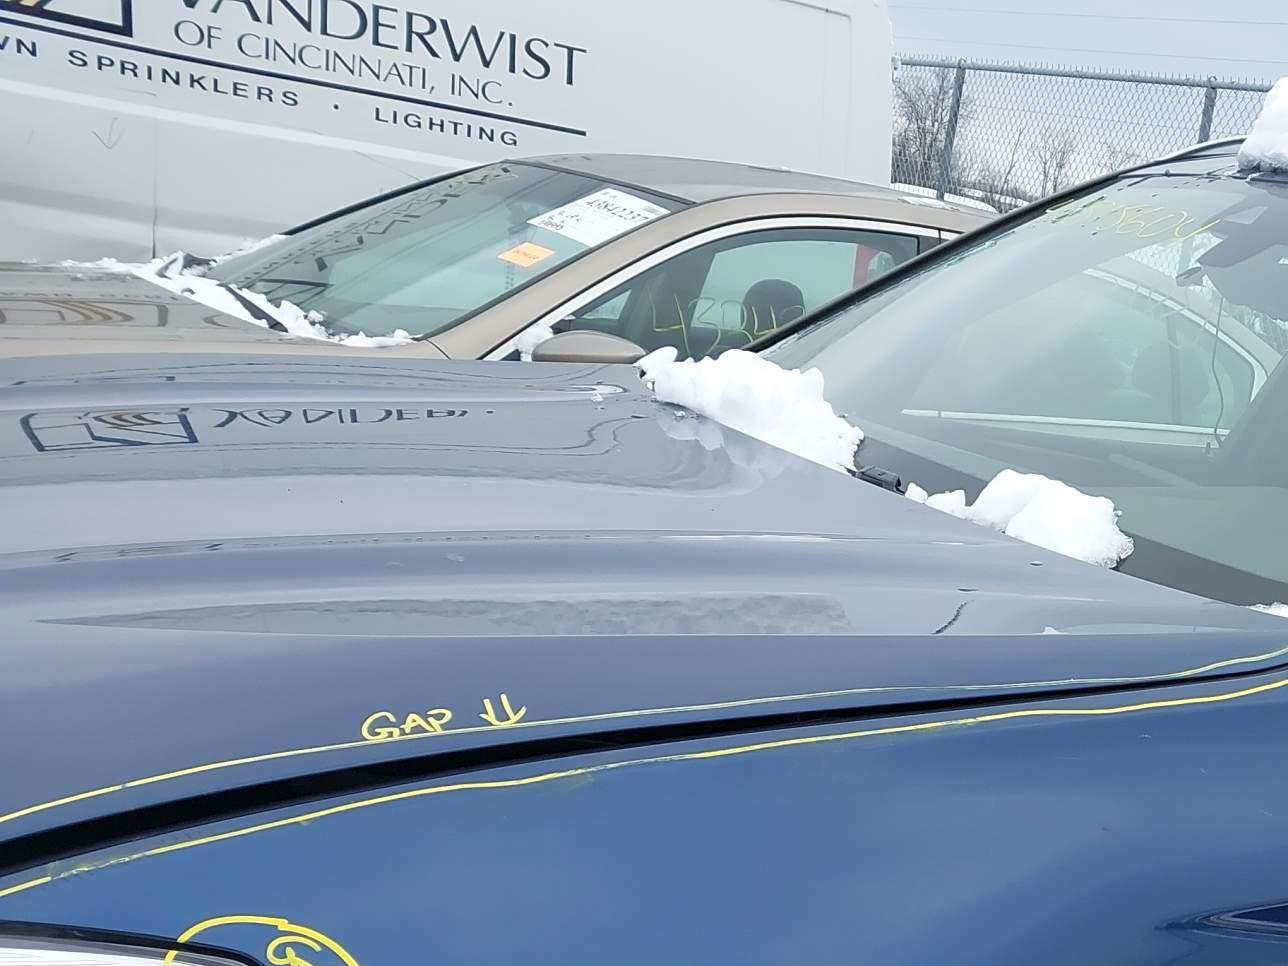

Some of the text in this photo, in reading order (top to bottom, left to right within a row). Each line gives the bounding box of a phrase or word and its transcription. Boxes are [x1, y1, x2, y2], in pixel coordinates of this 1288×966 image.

[173, 20, 514, 107] OF CINCINNATI, INC.
[181, 0, 587, 86] NDERWIST
[67, 50, 300, 107] SPRINKLERS
[375, 107, 518, 147] LIGHTING
[361, 708, 453, 741] GAP
